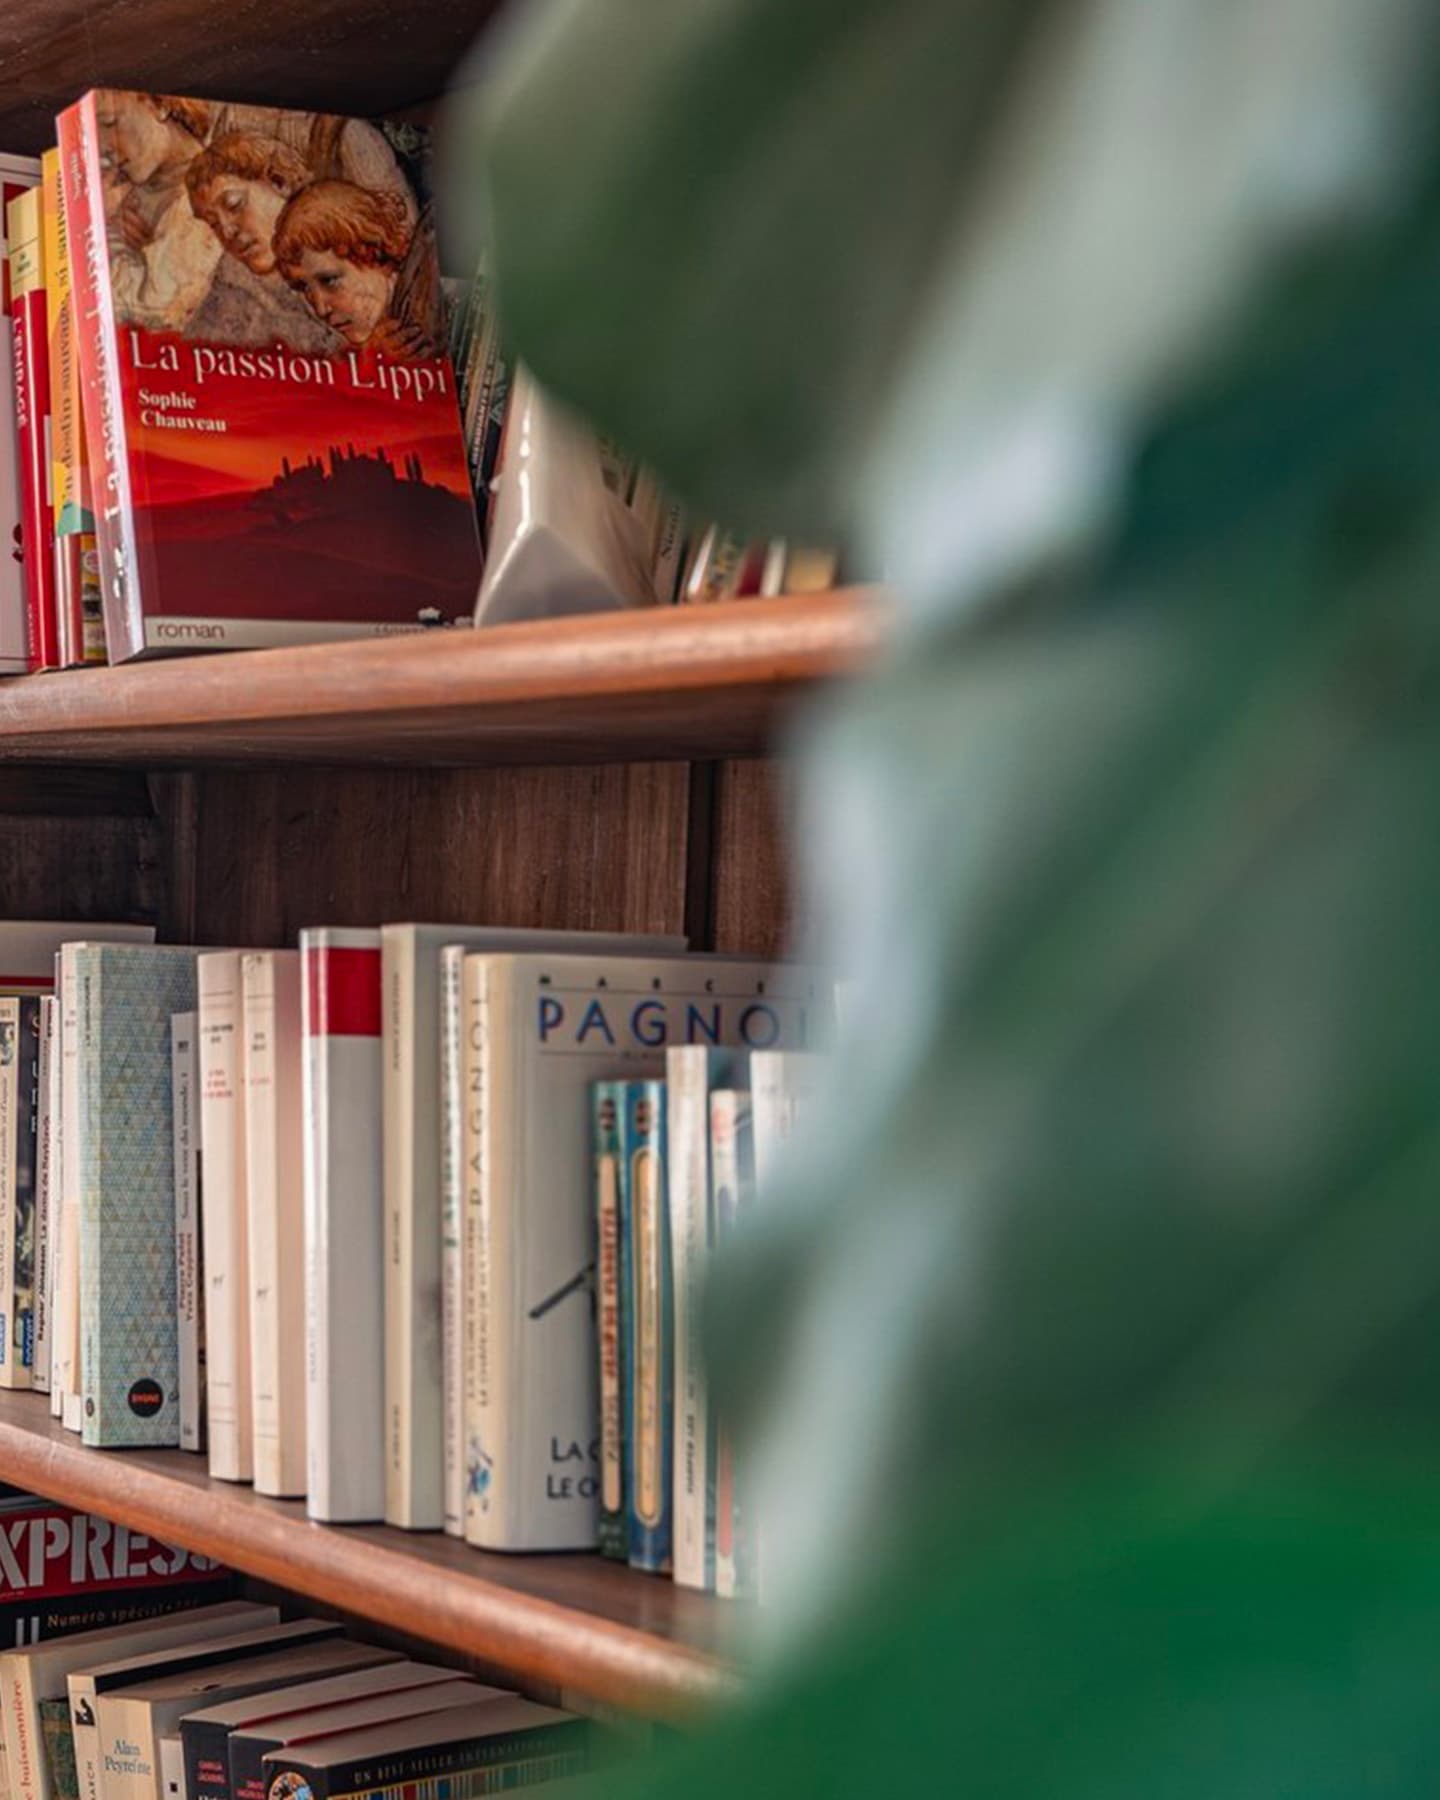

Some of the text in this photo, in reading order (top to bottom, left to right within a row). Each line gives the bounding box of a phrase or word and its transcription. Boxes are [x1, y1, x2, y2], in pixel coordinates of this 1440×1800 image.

[131, 332, 447, 402] La passion Lippi
[138, 388, 197, 409] Sophie
[141, 410, 227, 432] Chauveau
[58, 401, 73, 470] destin
[157, 621, 224, 640] roman
[41, 1115, 51, 1169] Reykjavik
[39, 1194, 48, 1222] dame
[185, 1232, 194, 1289] Coppens
[37, 1301, 48, 1341] Ragnar
[551, 1436, 583, 1462] LA
[546, 1473, 574, 1499] LE
[46, 1611, 106, 1630] Numéro
[13, 1680, 32, 1788] buissonnière
[115, 1738, 141, 1757] Alain
